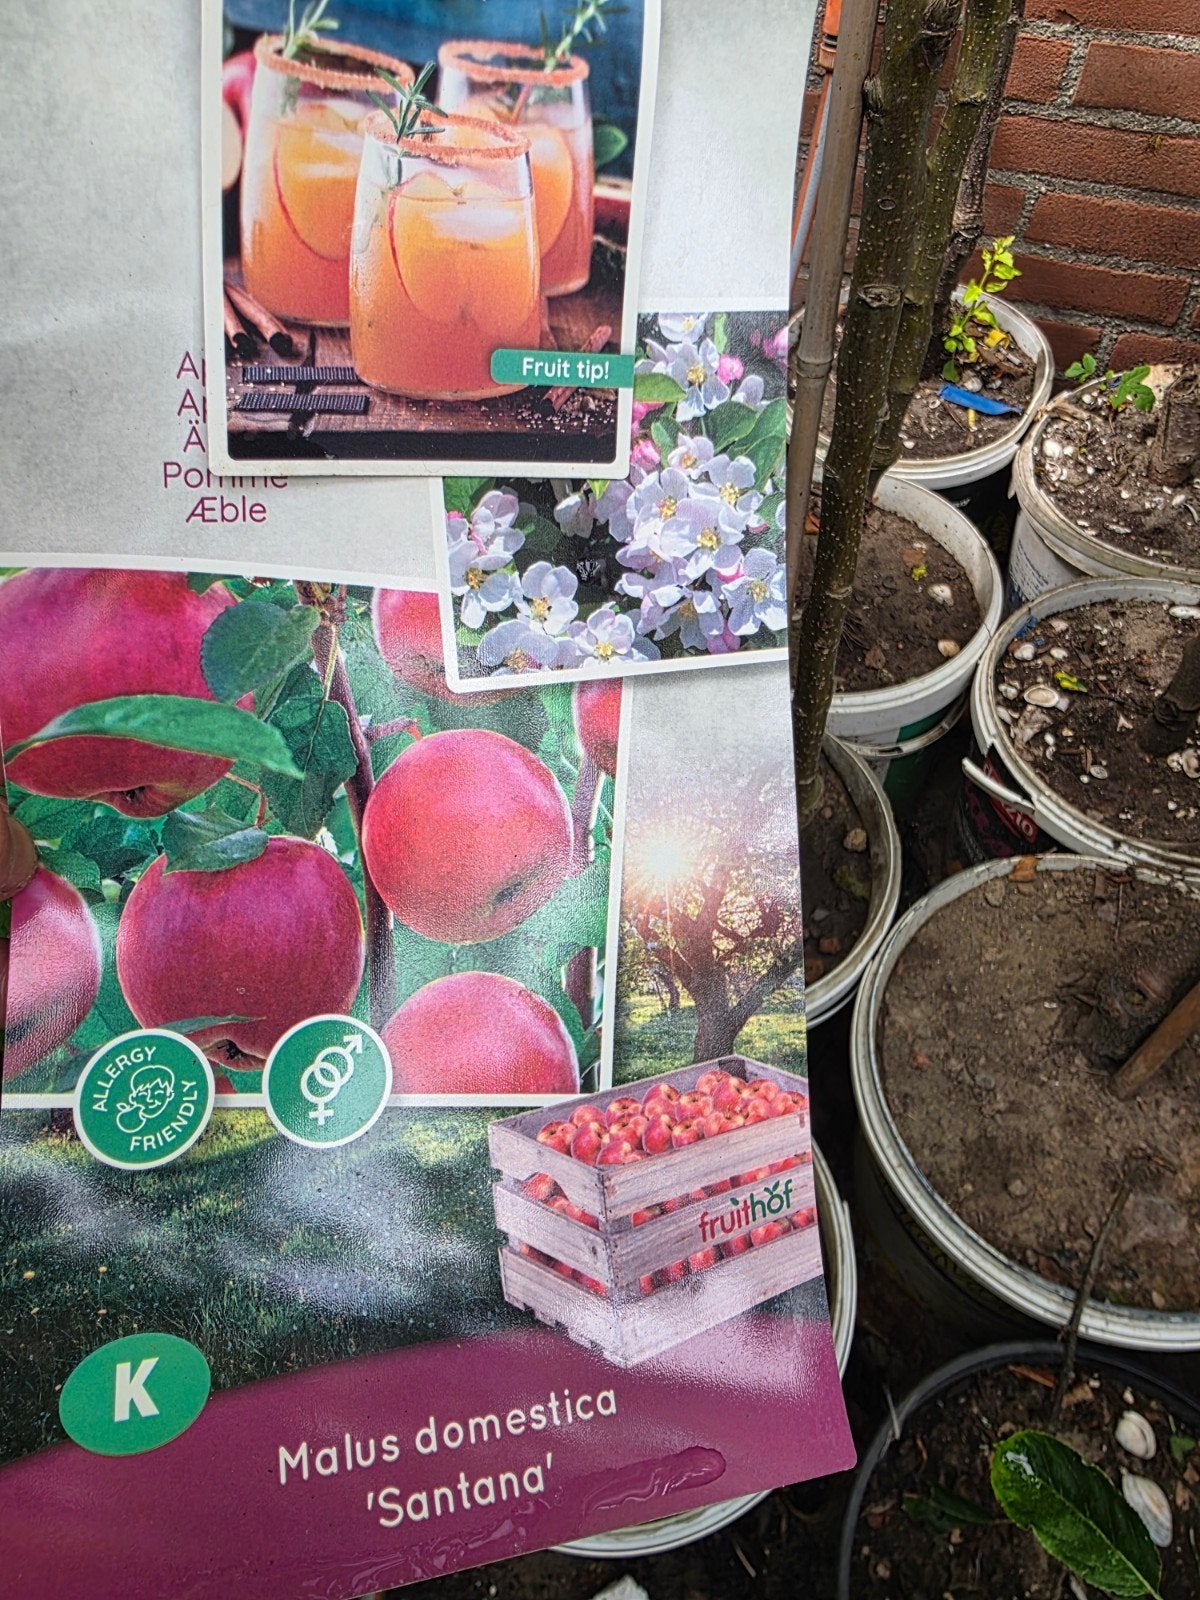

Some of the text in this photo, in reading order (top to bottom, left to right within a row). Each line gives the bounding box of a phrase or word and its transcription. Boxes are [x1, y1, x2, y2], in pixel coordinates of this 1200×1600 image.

[522, 357, 609, 383] Fruit tip!
[185, 495, 267, 523] Æble
[92, 1046, 156, 1112] ALLERGY
[129, 1080, 197, 1152] FRIENDLY
[699, 1178, 793, 1242] fruithof
[114, 1356, 160, 1423] K
[278, 1388, 618, 1486] Malus domestica
[366, 1451, 554, 1528] 'Santana'
